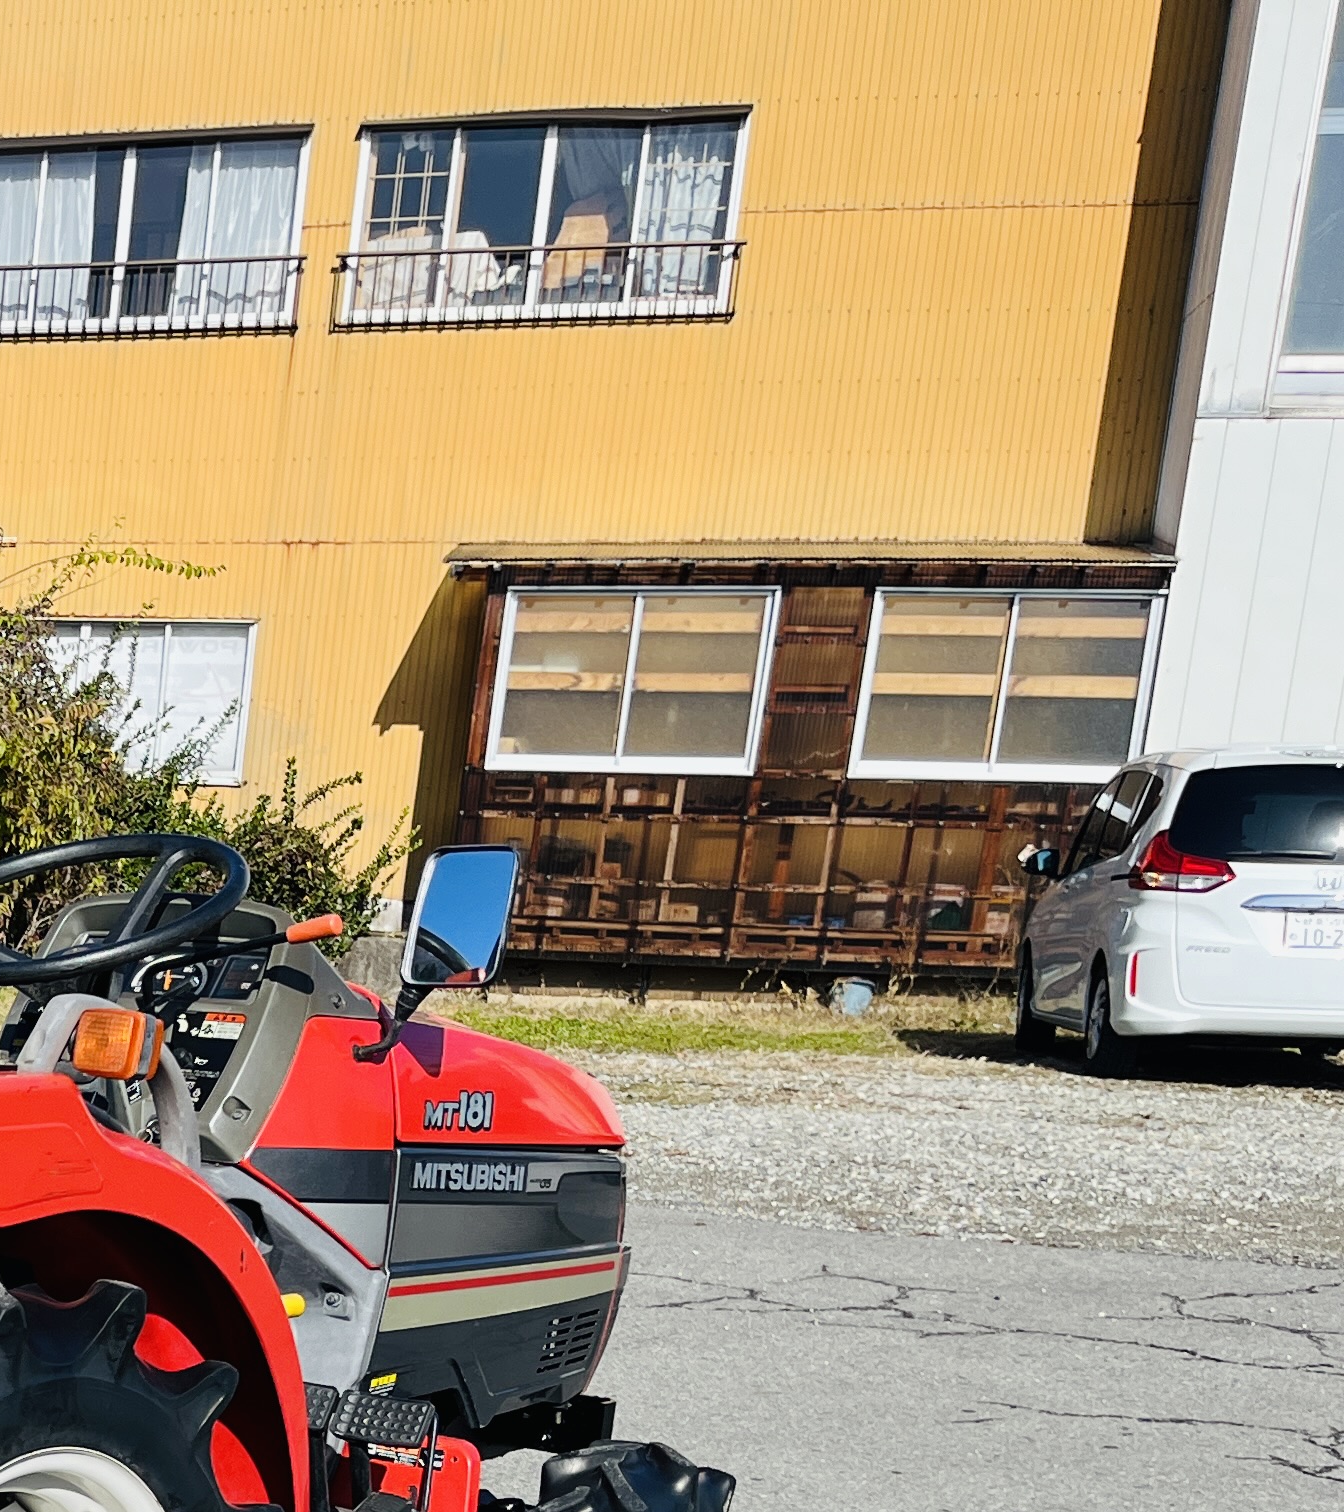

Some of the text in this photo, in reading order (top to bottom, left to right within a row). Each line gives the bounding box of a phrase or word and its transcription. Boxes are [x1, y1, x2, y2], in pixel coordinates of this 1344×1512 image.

[1303, 928, 1344, 946] 10-2
[423, 1090, 494, 1132] MT181
[411, 1161, 526, 1192] MITSUBISHI
